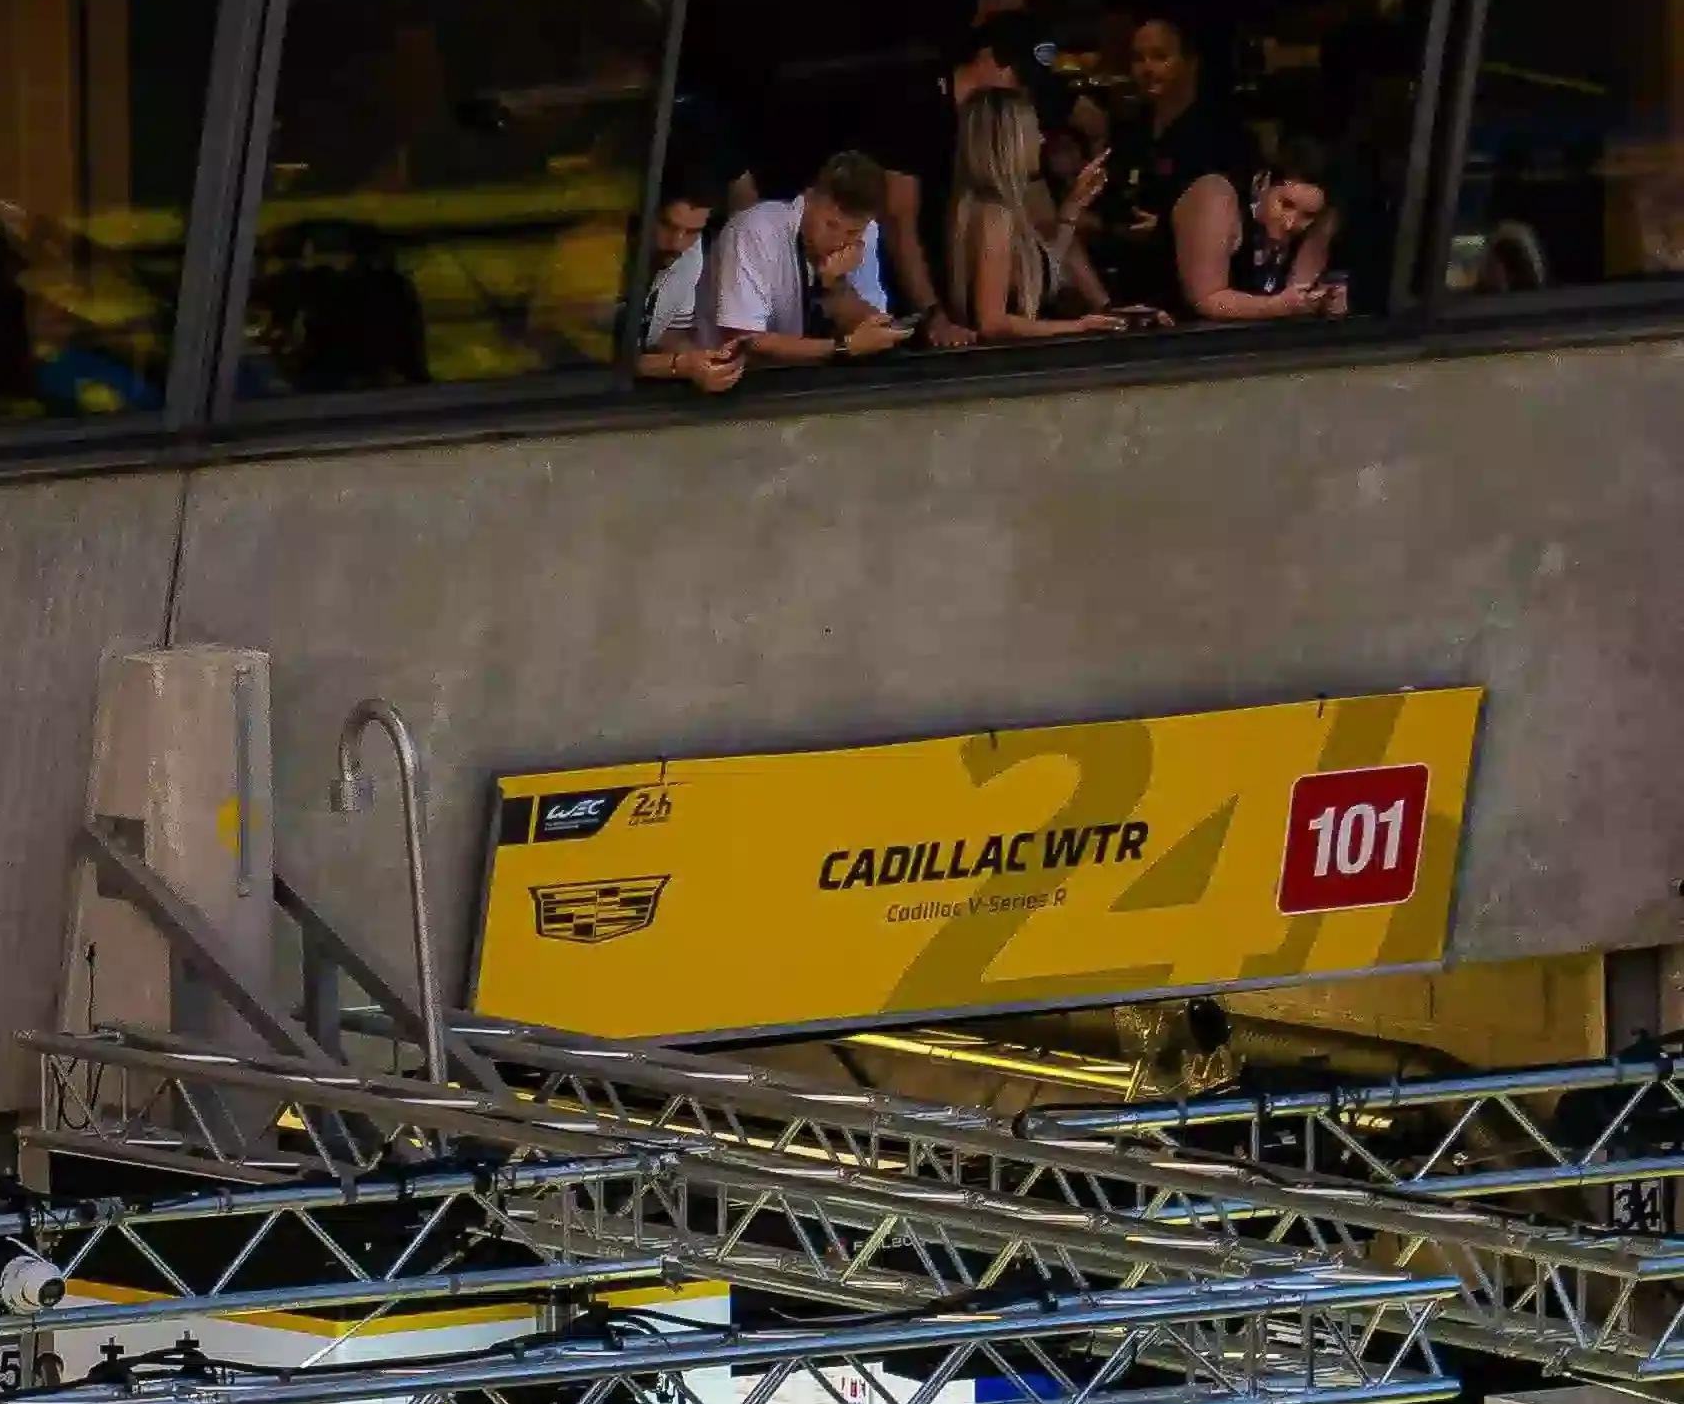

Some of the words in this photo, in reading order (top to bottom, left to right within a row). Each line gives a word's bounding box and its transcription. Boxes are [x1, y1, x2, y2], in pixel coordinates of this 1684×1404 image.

[546, 799, 606, 820] WEC
[818, 831, 1036, 890] CADILLAC
[1042, 821, 1149, 868] WTR
[1308, 798, 1407, 878] 101
[886, 900, 962, 924] Cadillac
[968, 892, 1049, 916] V-Series
[1052, 889, 1067, 907] R
